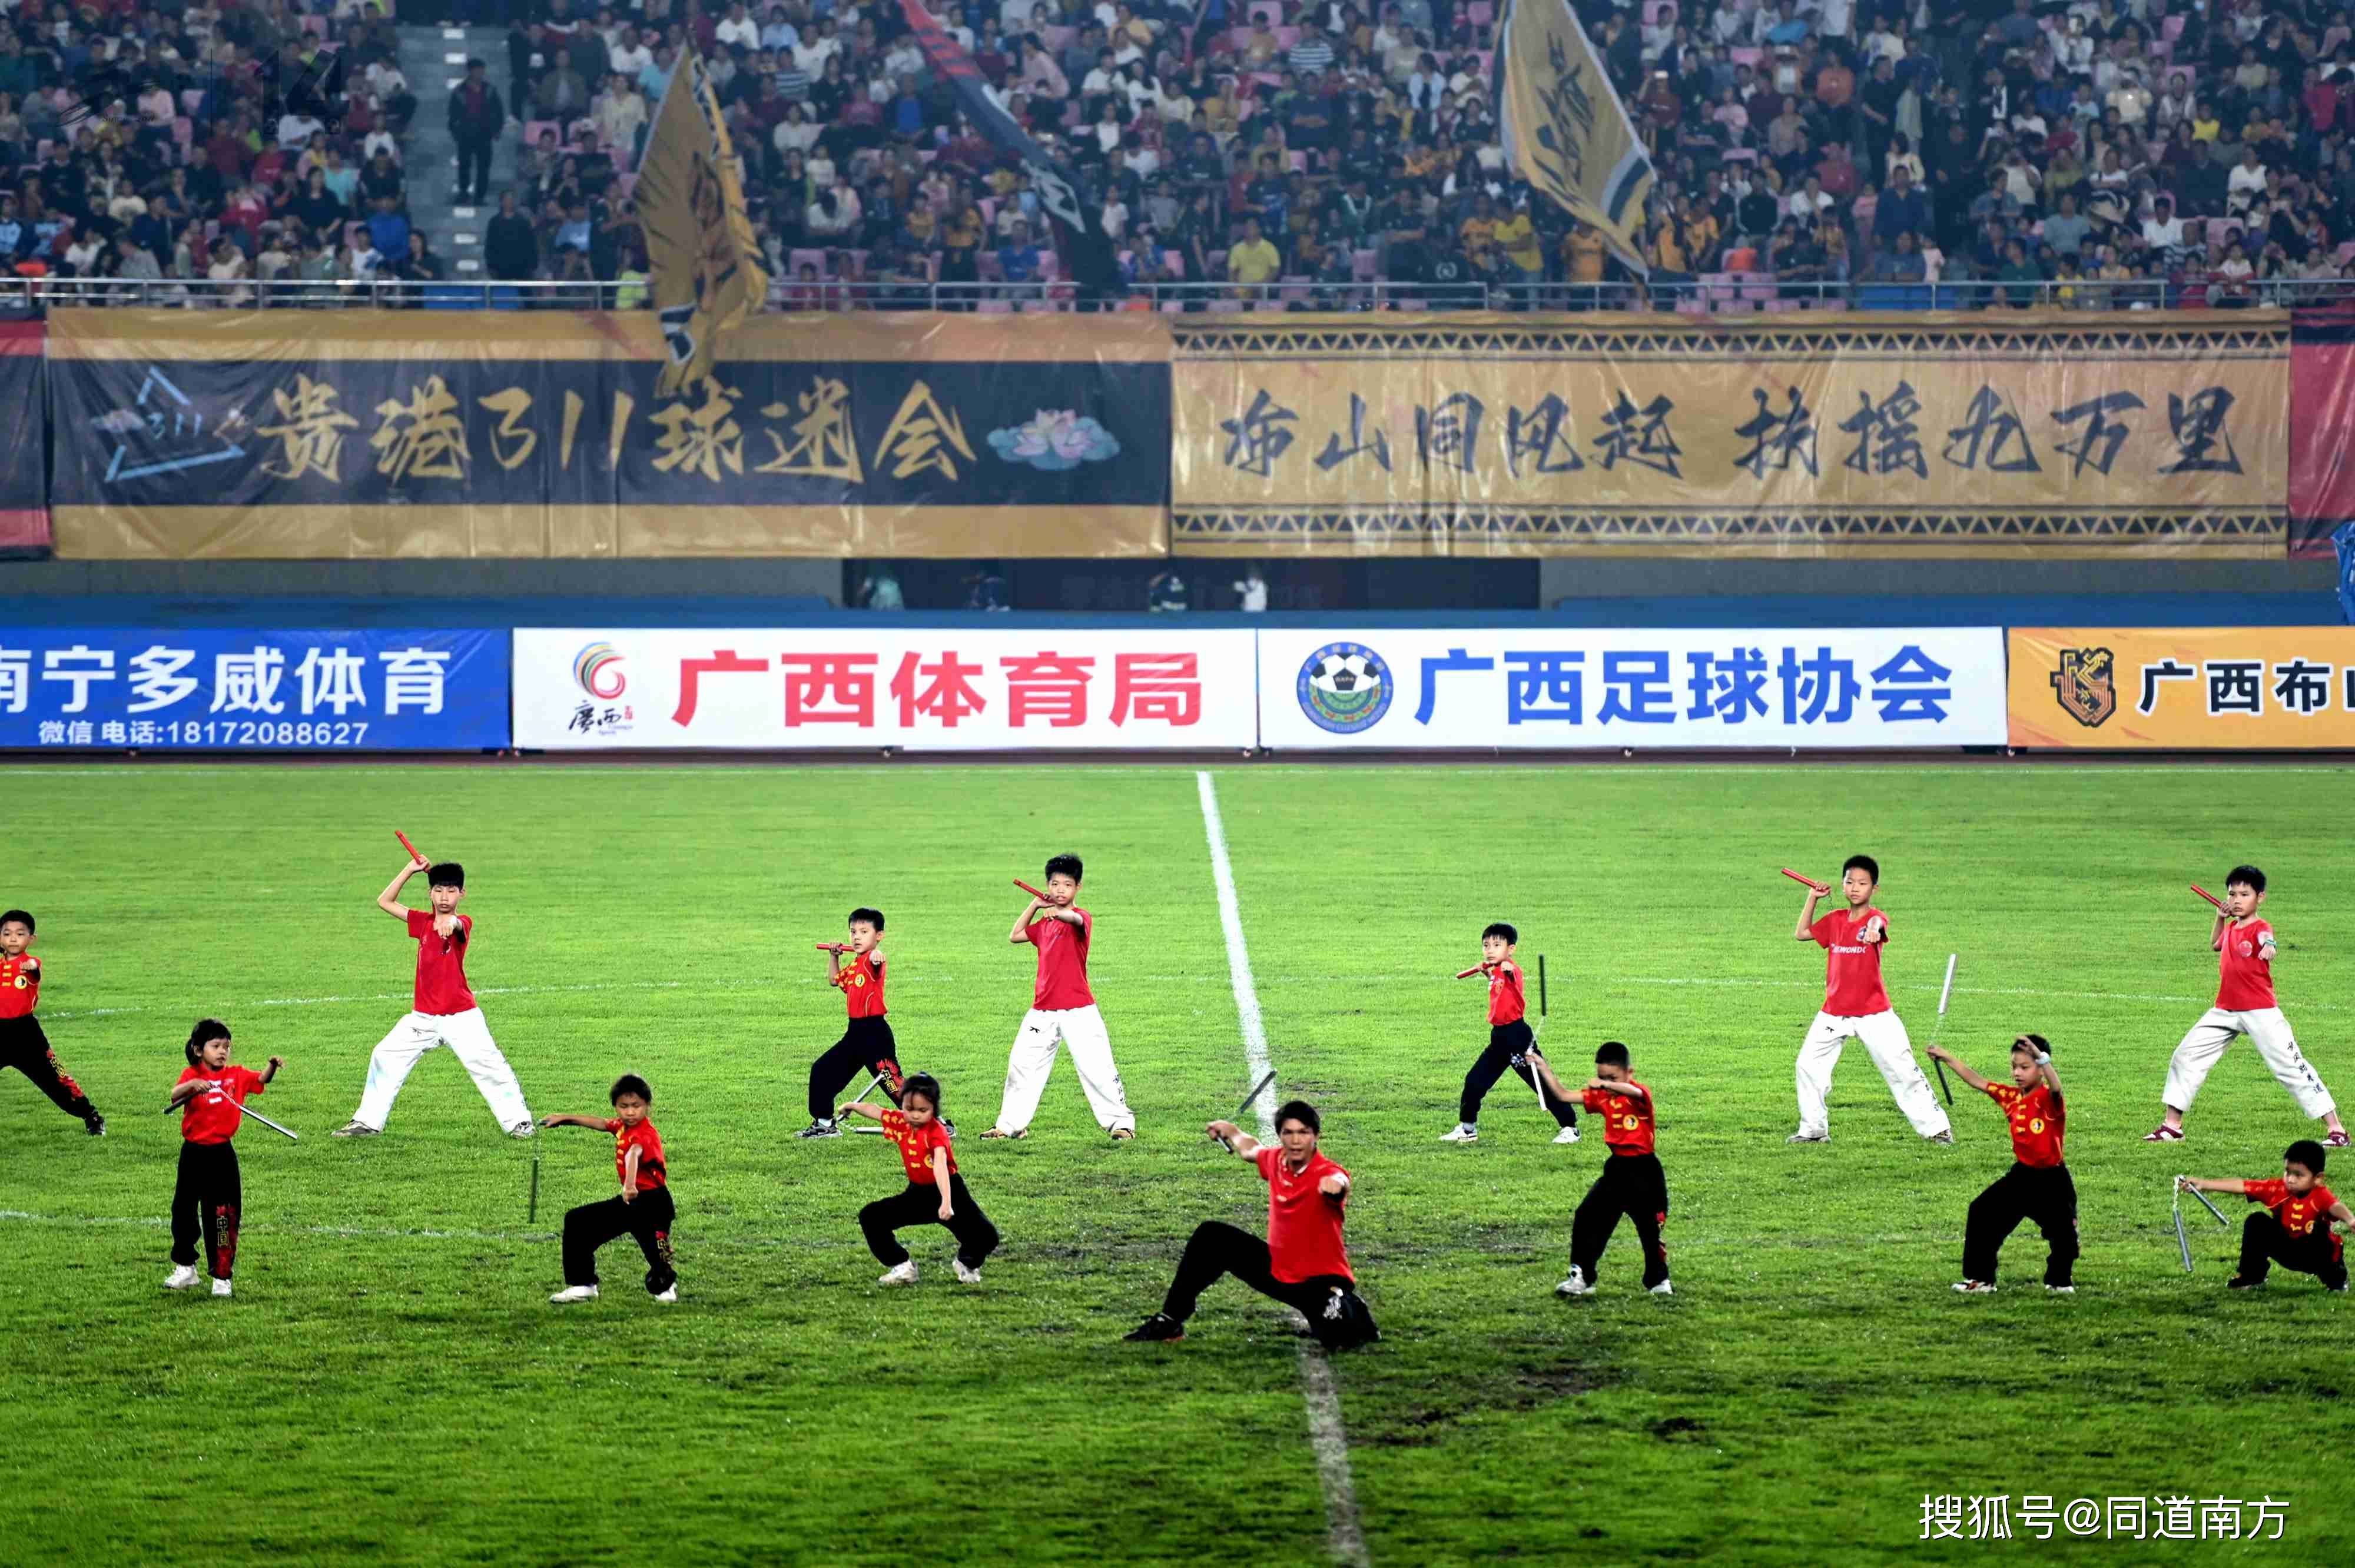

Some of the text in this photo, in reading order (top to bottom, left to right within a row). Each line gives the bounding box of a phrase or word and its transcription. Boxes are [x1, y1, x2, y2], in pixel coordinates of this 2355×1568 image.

[1733, 380, 2244, 480] 扶摇九万里
[671, 649, 1202, 728] 广西体育局
[1414, 645, 1953, 726] 广西足球协会
[2138, 660, 2355, 713] 广西布
[38, 720, 369, 745] 微信 电话:18172088627
[880, 1069, 898, 1093] 中国
[216, 1215, 230, 1248] 中国
